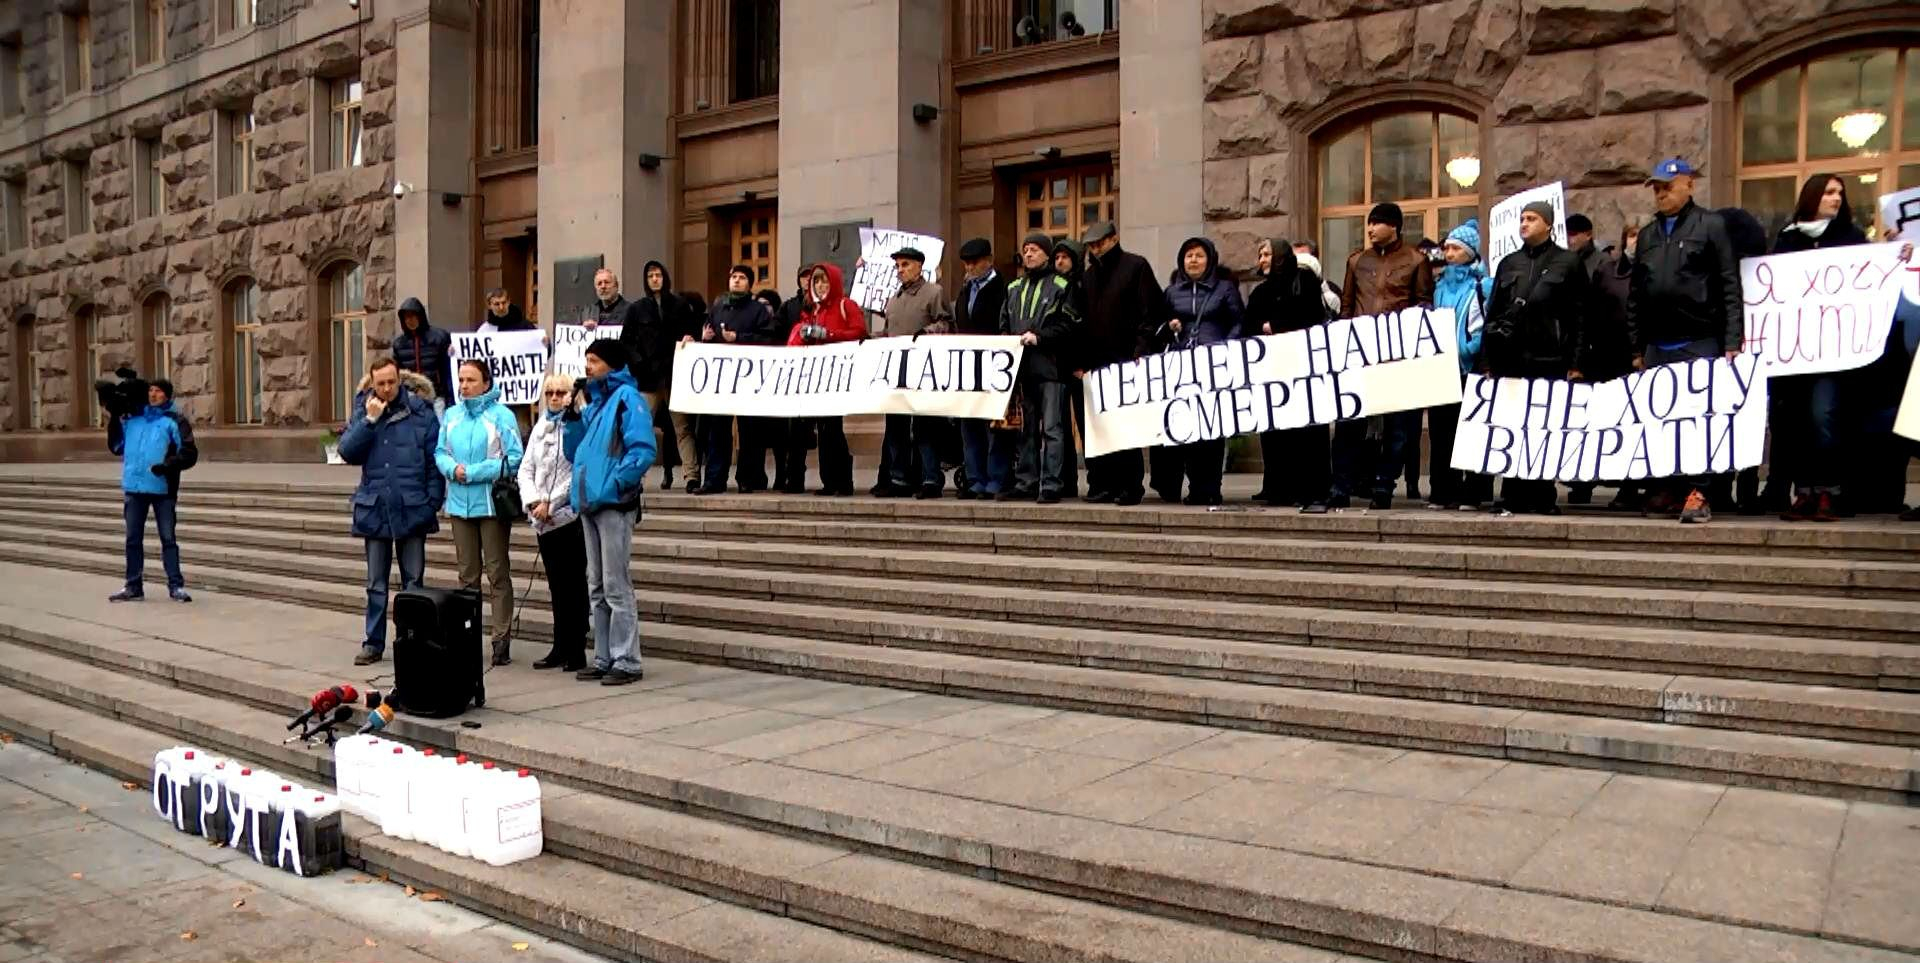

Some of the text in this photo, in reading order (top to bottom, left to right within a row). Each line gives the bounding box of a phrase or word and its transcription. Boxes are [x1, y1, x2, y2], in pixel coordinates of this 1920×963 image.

[459, 336, 495, 358] НАС
[869, 346, 1016, 393] ДІАЛІЗ
[1090, 306, 1445, 413] ТЕНДЕР НАША
[1163, 371, 1363, 444] СМЕРТЬ
[1462, 353, 1763, 430] Я НЕ ХОЧУ
[1481, 413, 1736, 480] ВМИРАТИ
